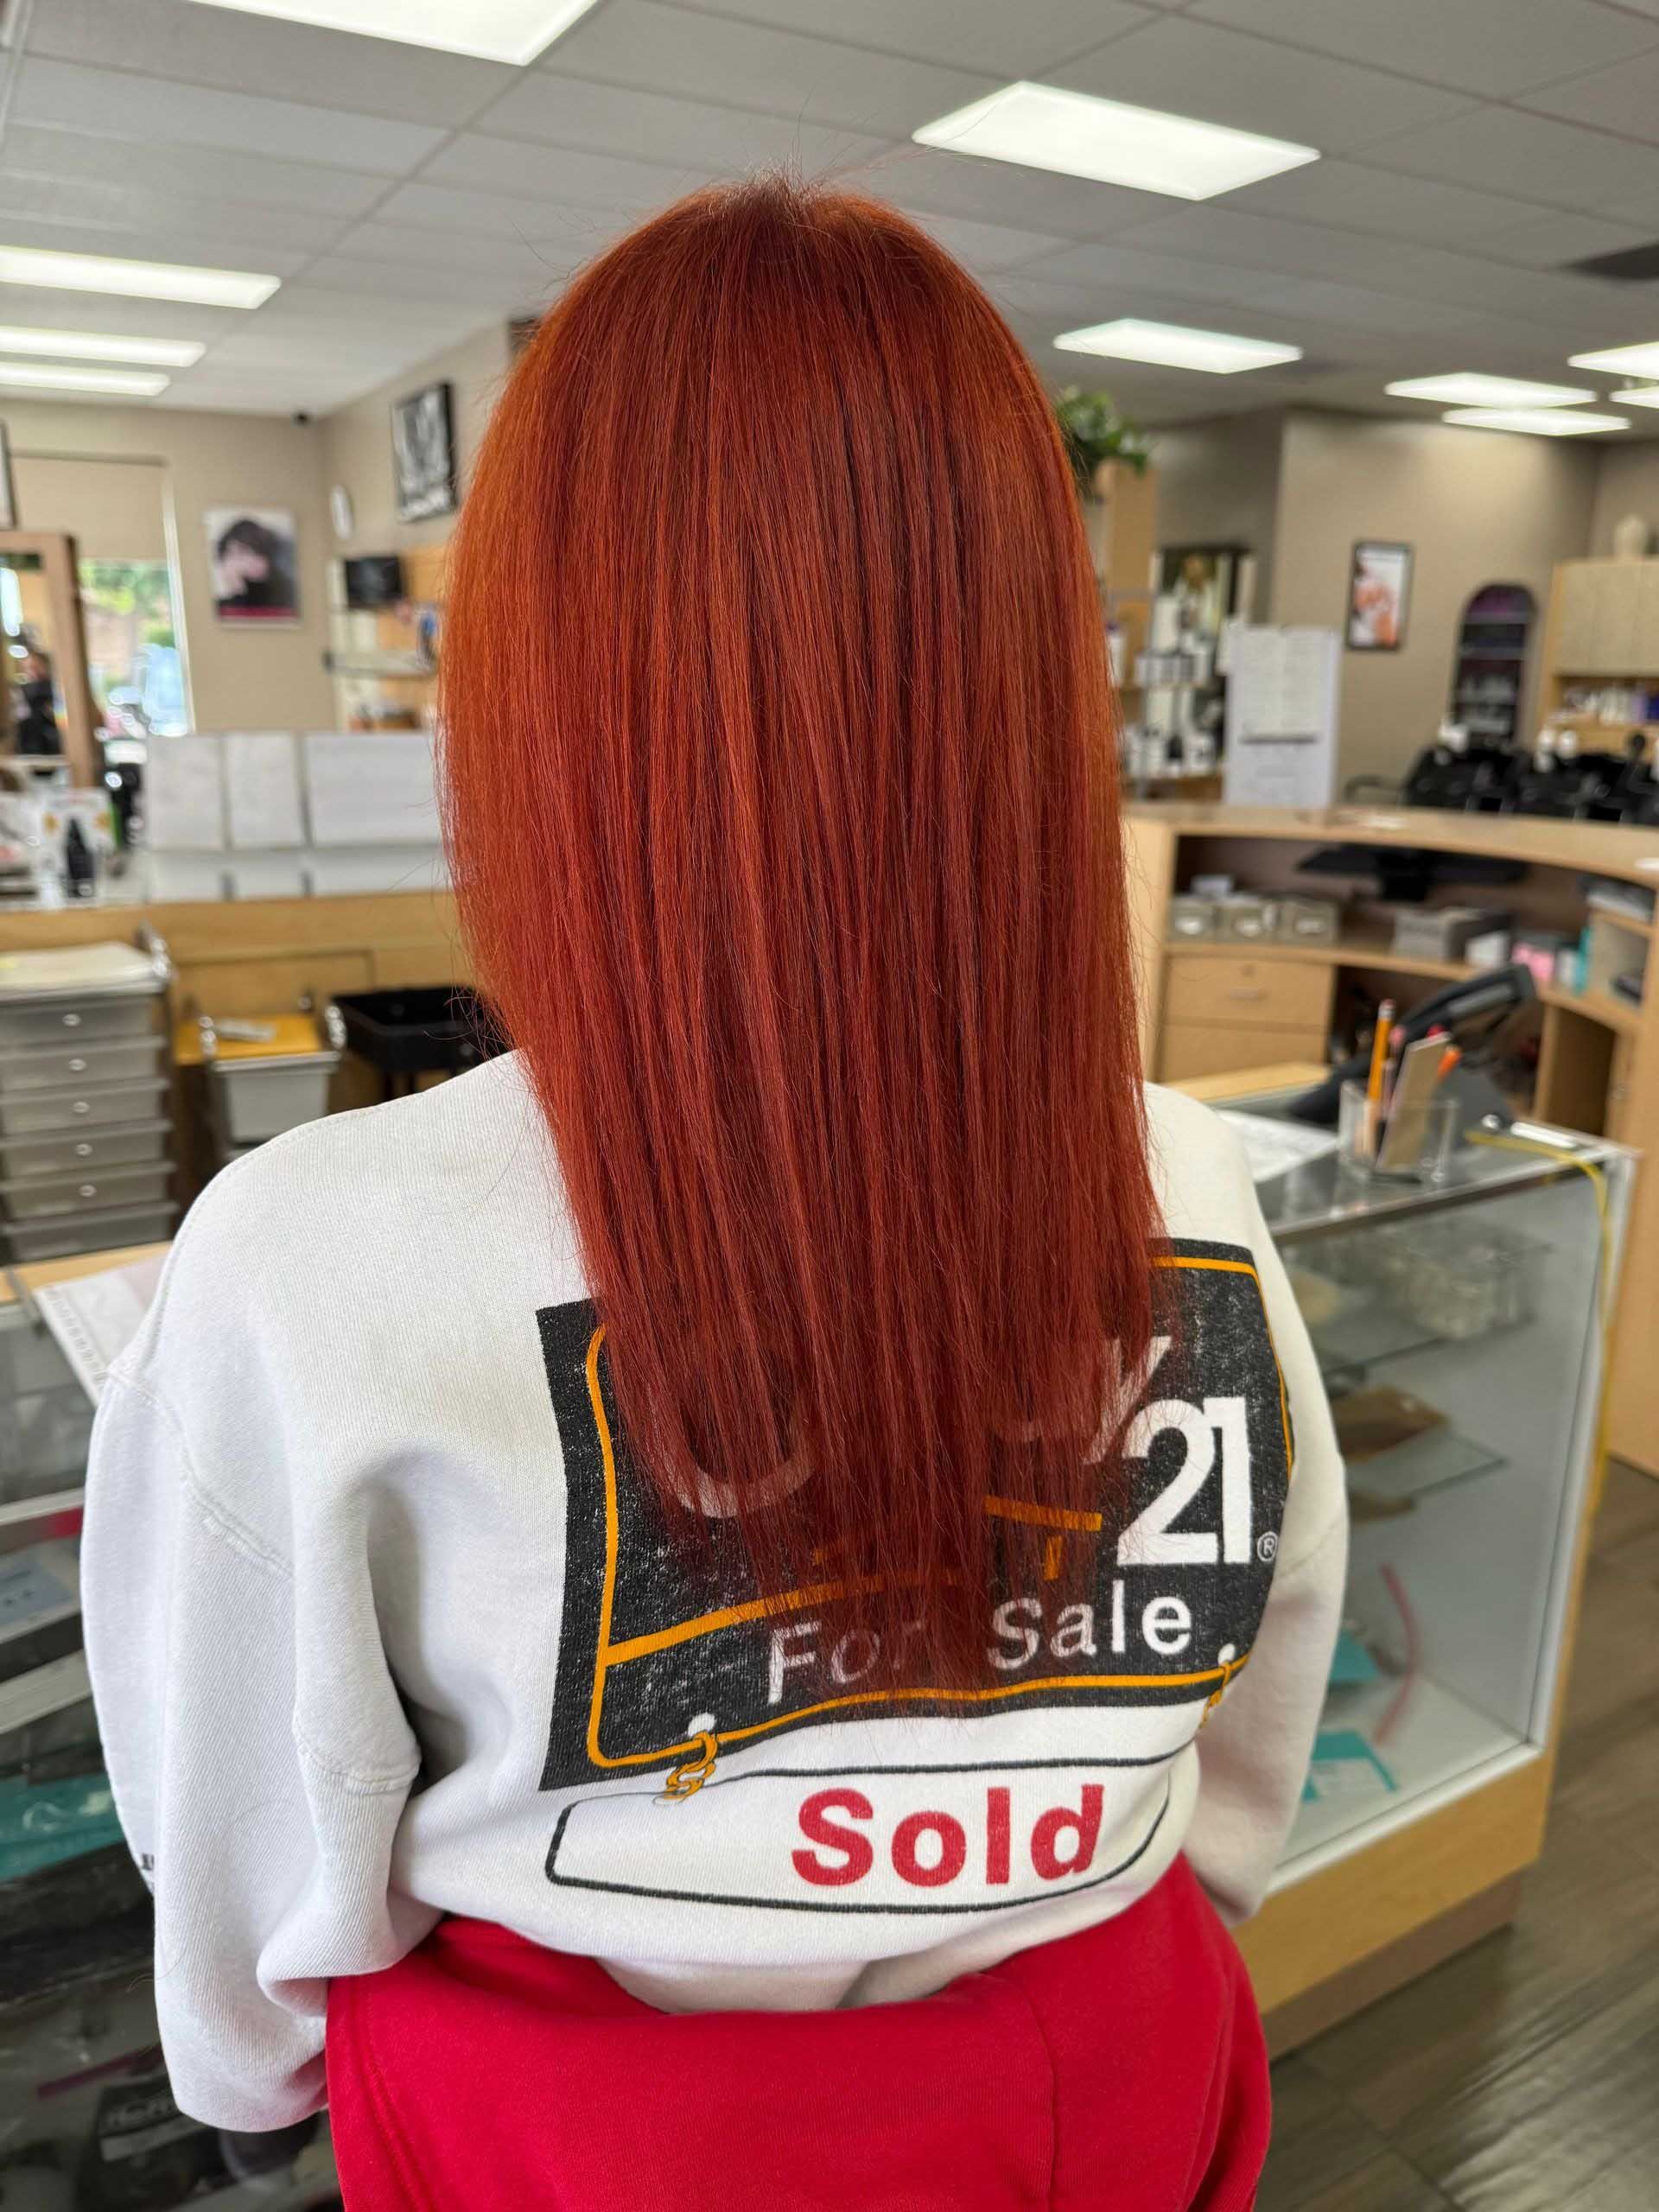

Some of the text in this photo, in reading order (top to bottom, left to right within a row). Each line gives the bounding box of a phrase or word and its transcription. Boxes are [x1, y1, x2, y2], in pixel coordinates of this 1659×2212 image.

[1117, 1396, 1250, 1565] 21
[987, 1579, 1192, 1670] Sale
[791, 1784, 1104, 1887] Sold
